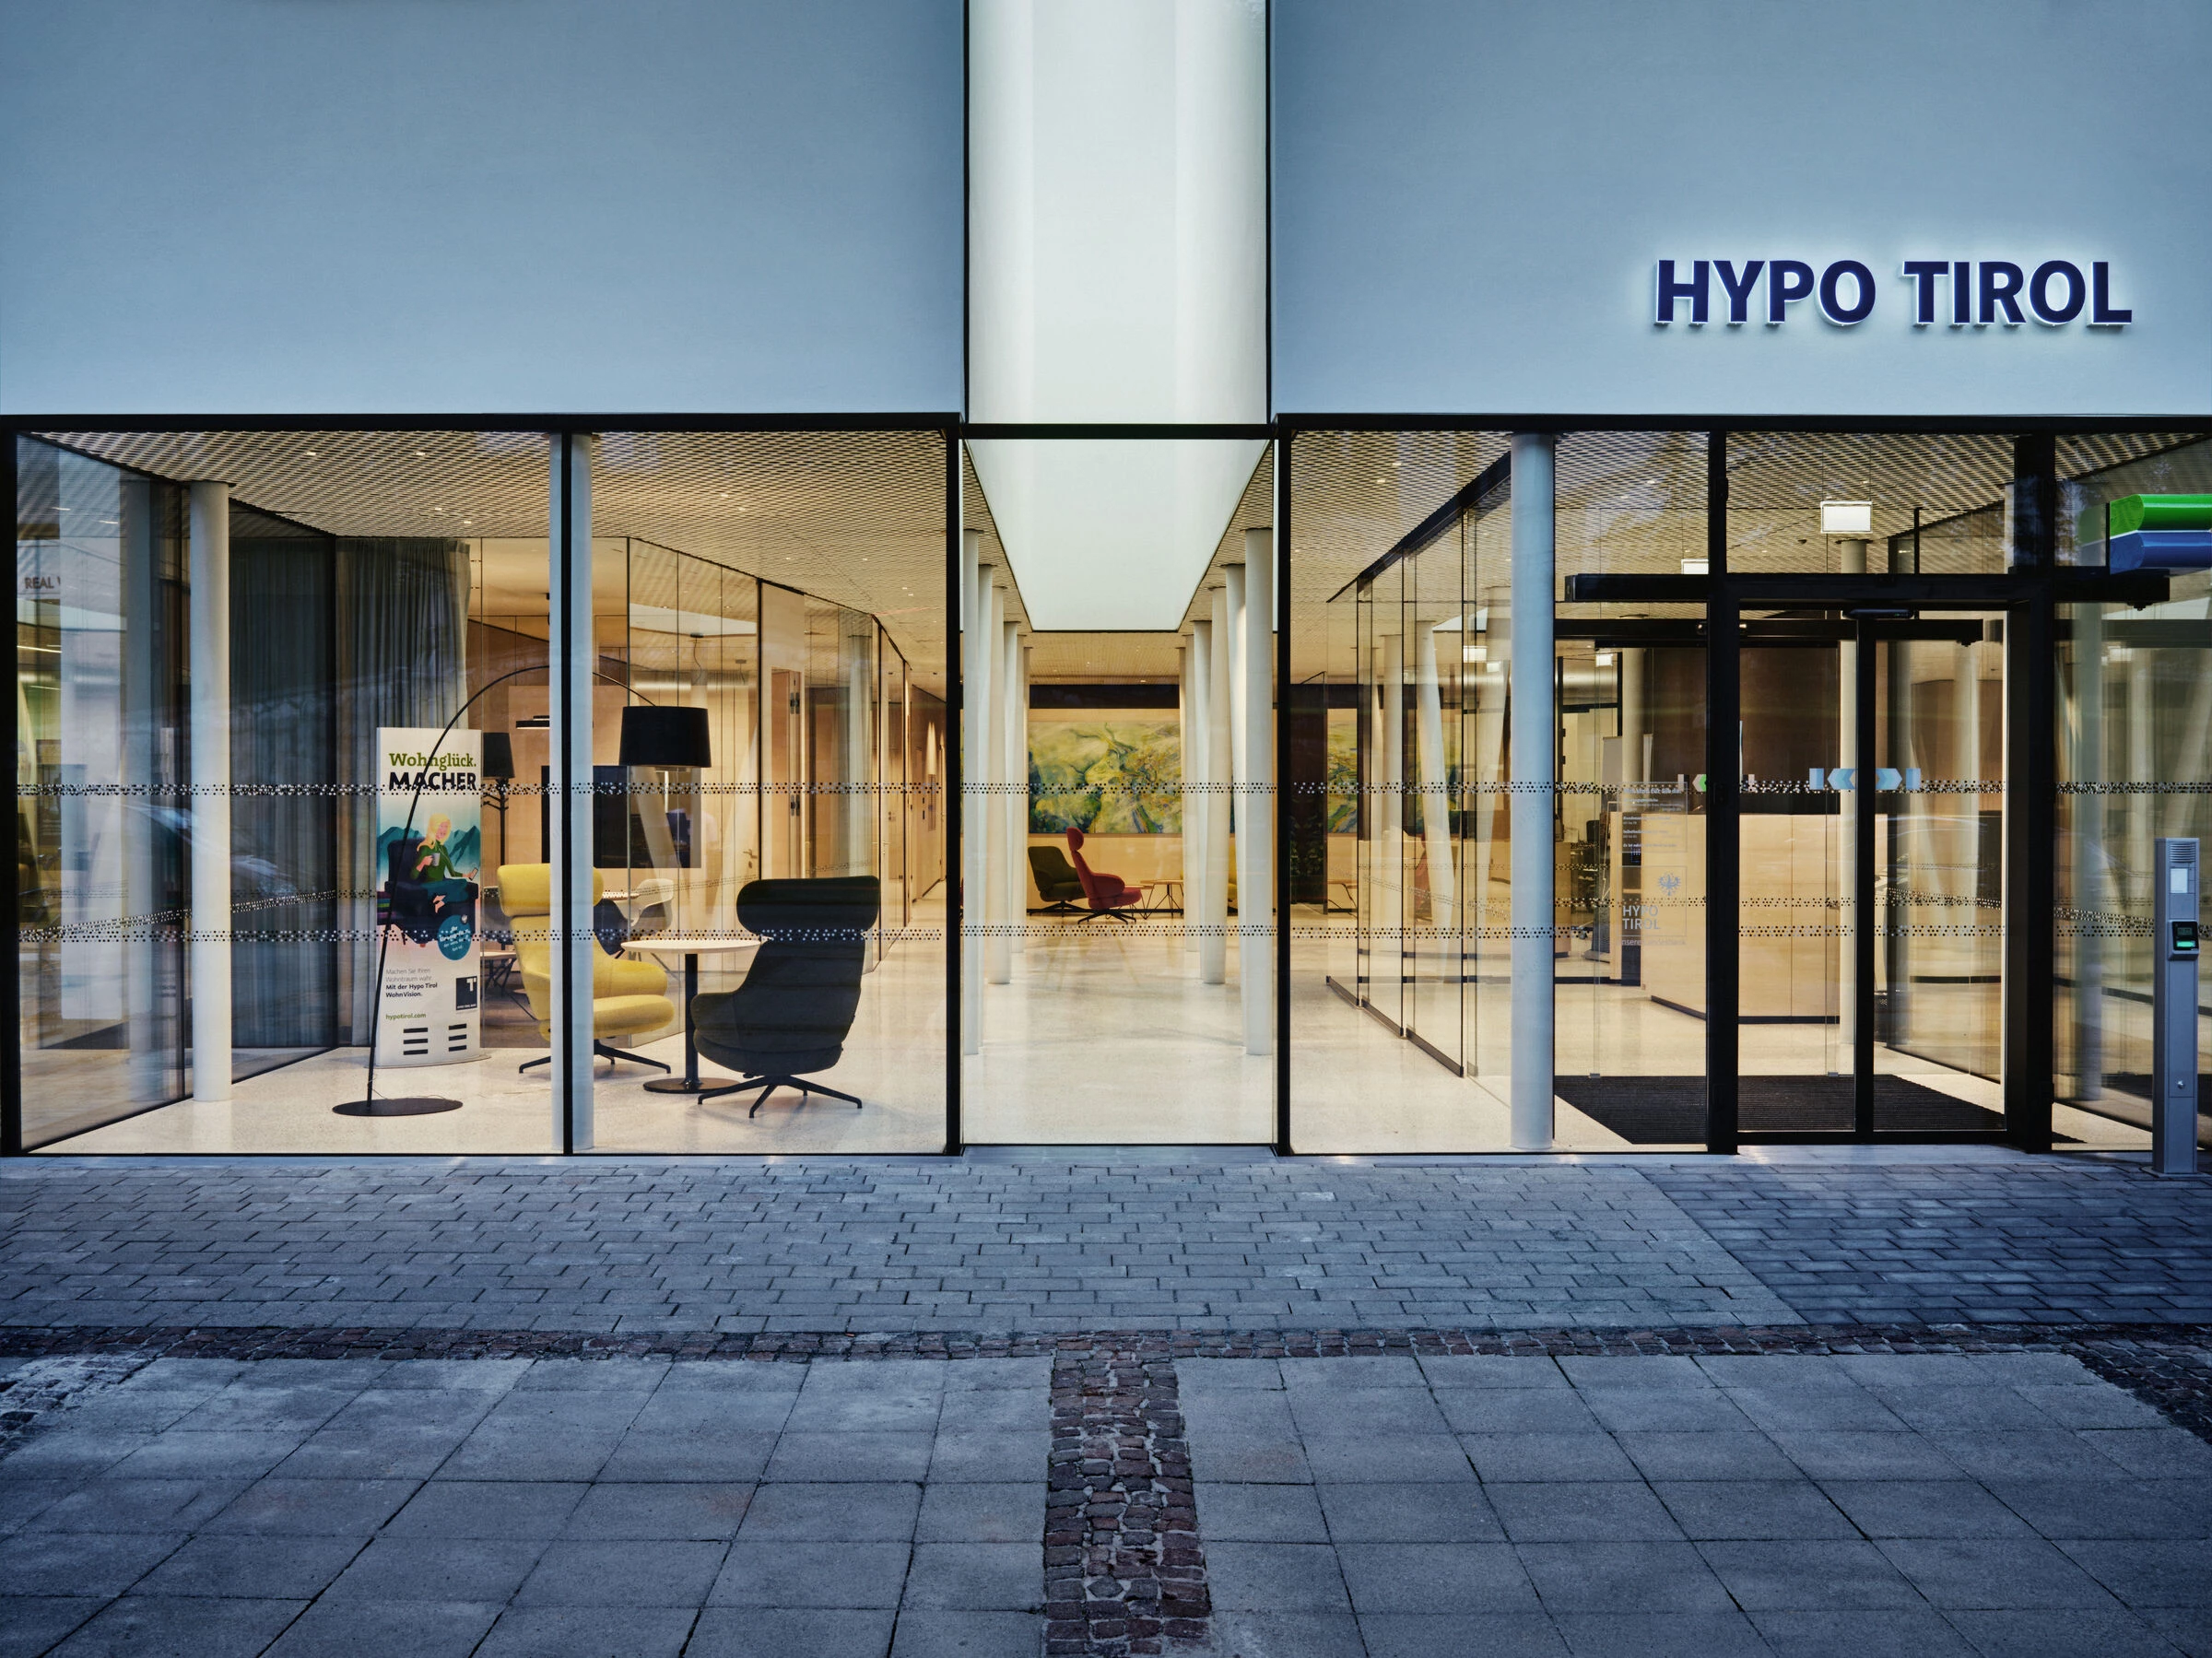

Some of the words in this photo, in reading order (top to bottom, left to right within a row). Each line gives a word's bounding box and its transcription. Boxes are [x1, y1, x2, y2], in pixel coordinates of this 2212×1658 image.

[1656, 259, 1877, 324] HYPO
[1902, 260, 2133, 325] TIROL
[24, 575, 54, 590] REAL
[388, 752, 477, 771] Wohnglück.
[389, 771, 477, 791] MACHER
[1622, 904, 1659, 917] HYPO
[1621, 918, 1661, 930] TIROL
